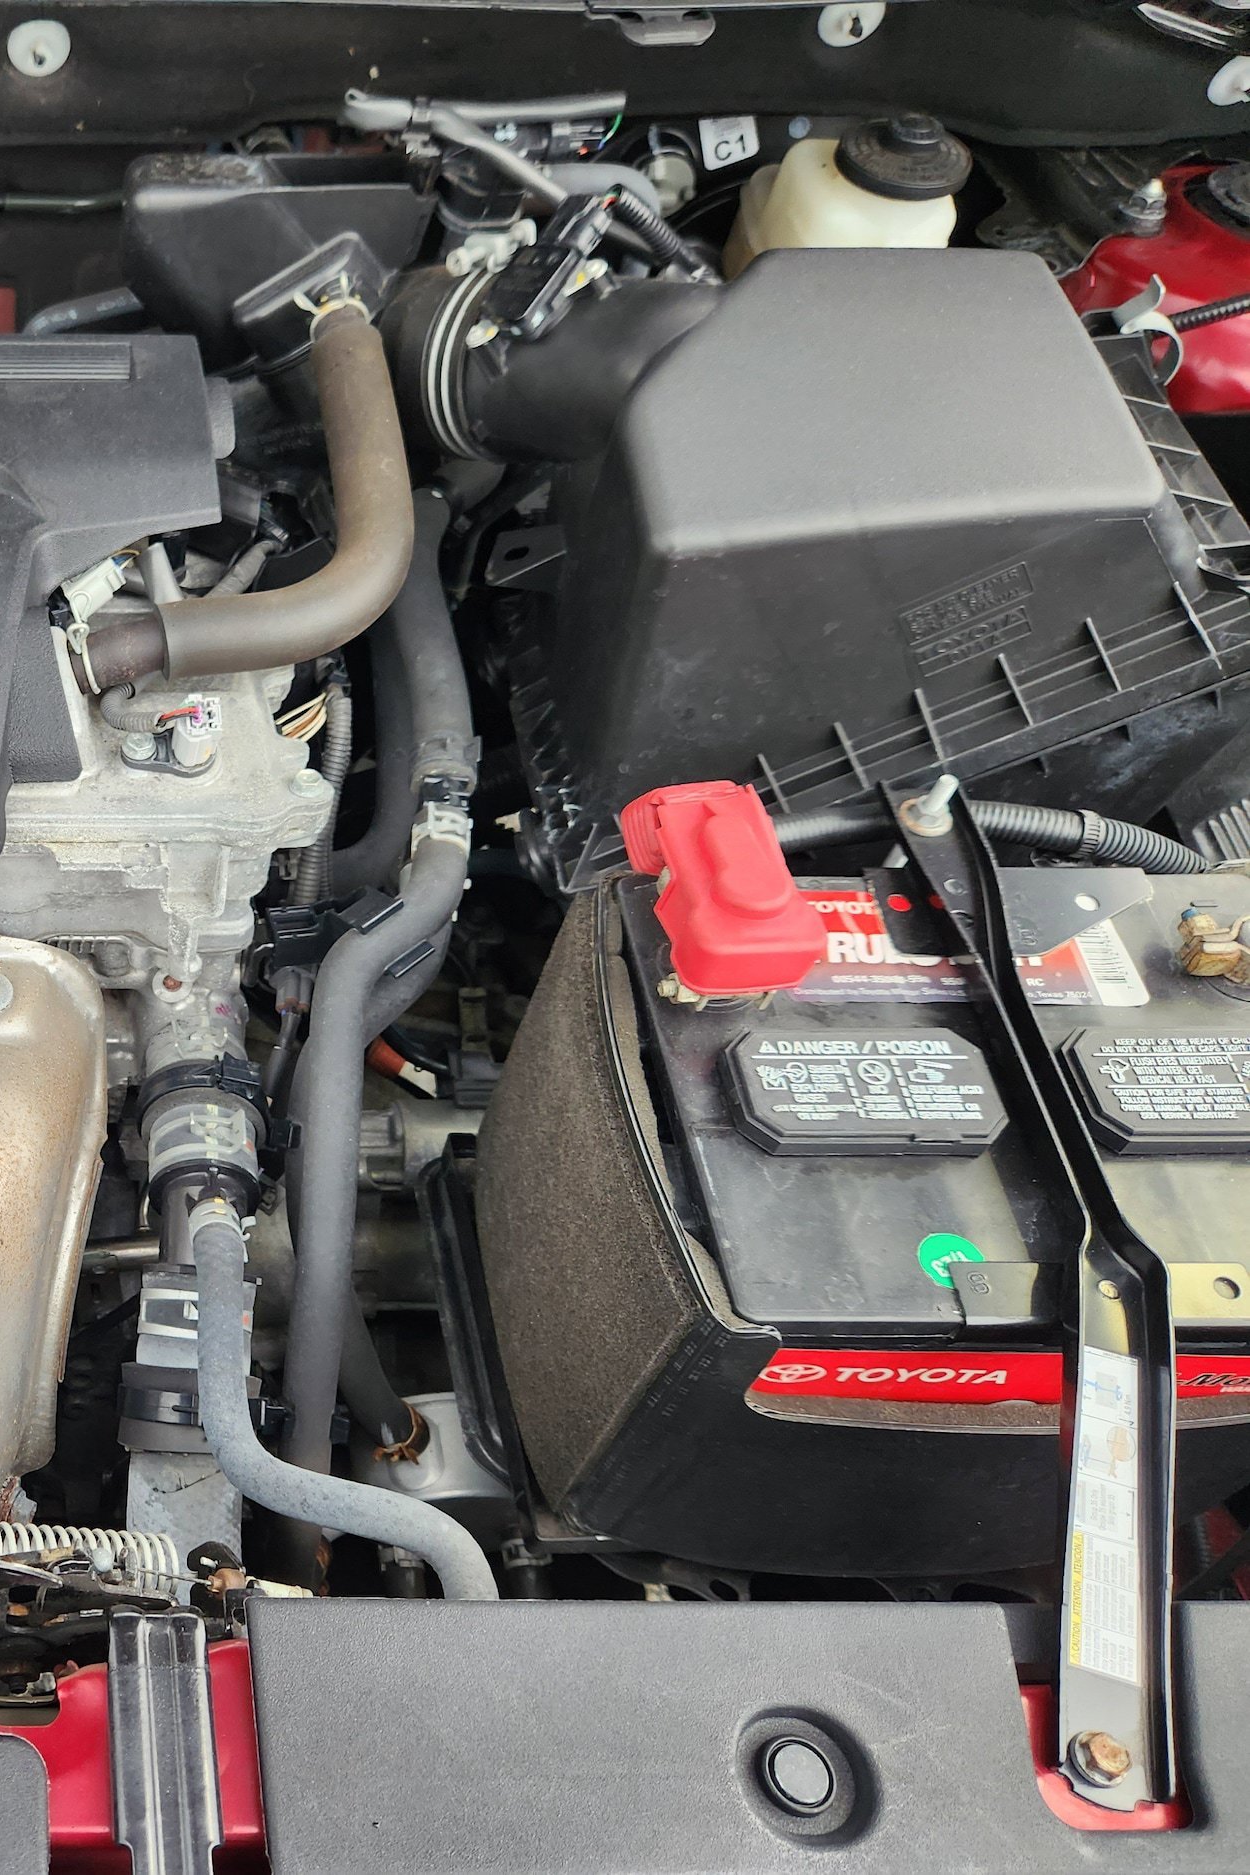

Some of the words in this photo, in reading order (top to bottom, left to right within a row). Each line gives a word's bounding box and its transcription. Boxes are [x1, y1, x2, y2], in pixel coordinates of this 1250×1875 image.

[714, 134, 748, 162] C1
[959, 568, 1018, 601] CLEANER
[918, 610, 1025, 659] TOYOTA
[807, 901, 878, 915] OYOT
[1026, 978, 1045, 986] RC
[776, 1041, 859, 1055] DANGER
[861, 1041, 873, 1055] /
[875, 1040, 952, 1055] POISON
[1114, 1038, 1136, 1046] KEEP
[1136, 1038, 1155, 1046] OUT
[1156, 1038, 1168, 1046] OF
[1188, 1037, 1216, 1045] REACH
[1217, 1037, 1229, 1045] OF
[1128, 1057, 1155, 1066] FLUSH
[1156, 1057, 1178, 1065] EYES
[1178, 1056, 1229, 1065] IMMEDIATELY
[1132, 1066, 1155, 1075] WITH
[1186, 1066, 1203, 1075] GET
[1137, 1075, 1174, 1084] MEDICAL
[1174, 1075, 1195, 1084] HELP
[1195, 1074, 1217, 1084] FAST
[790, 1083, 846, 1093] EXPLOSIVE
[1206, 1088, 1244, 1096] STARTING
[835, 1367, 1007, 1385] TOYOTA
[1071, 1622, 1081, 1651] CAUTION
